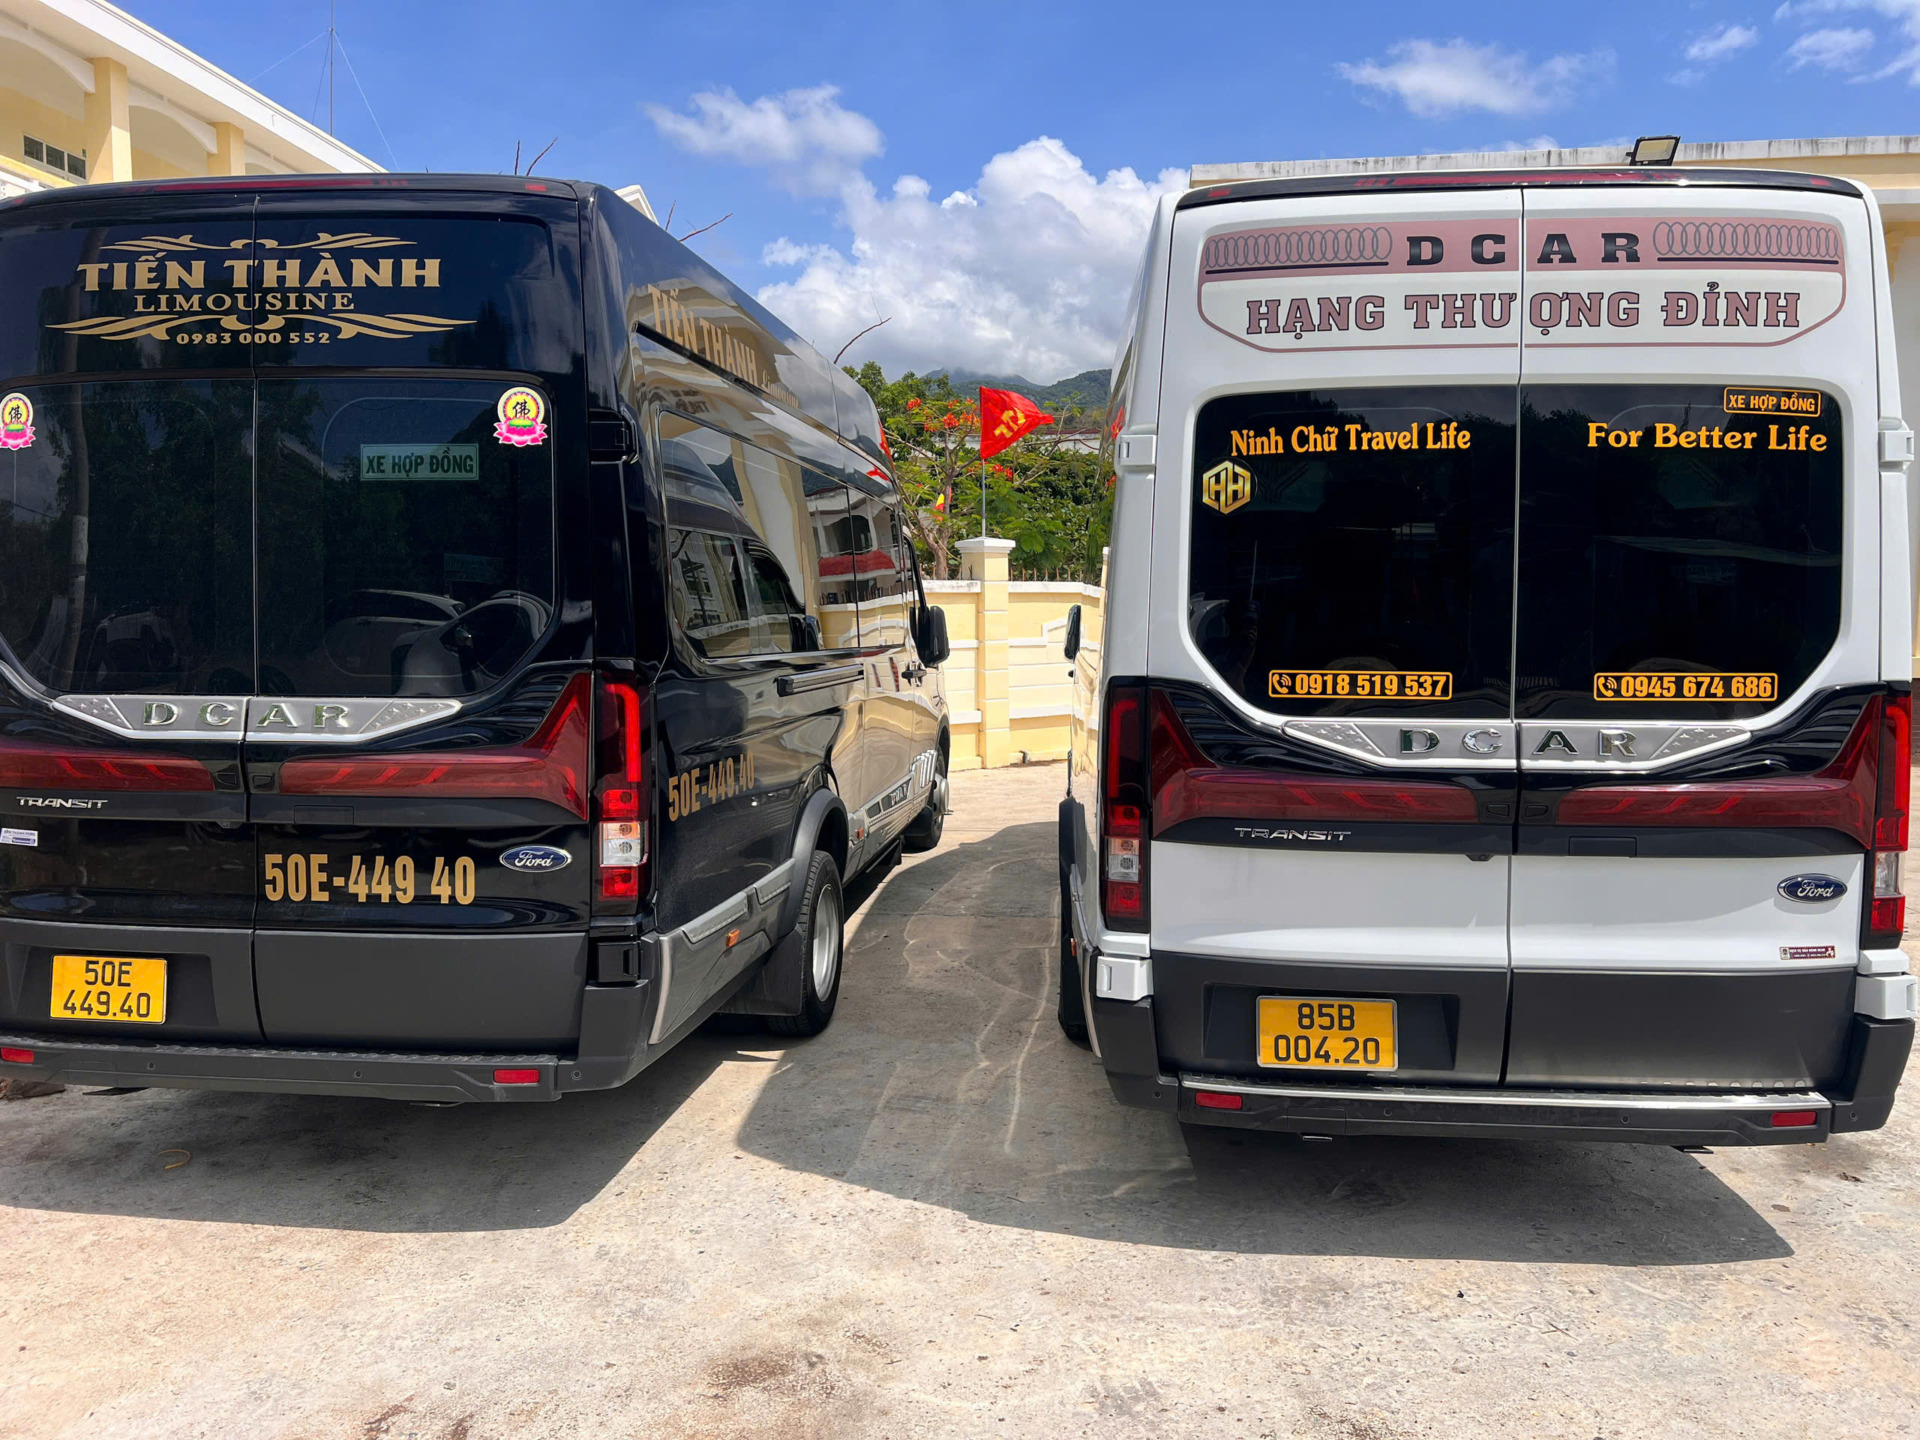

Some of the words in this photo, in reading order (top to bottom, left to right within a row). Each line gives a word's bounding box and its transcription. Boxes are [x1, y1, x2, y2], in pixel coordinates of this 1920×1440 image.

[76, 252, 206, 291] TIẾN
[223, 252, 441, 288] THÀNH
[134, 292, 355, 312] LIMOUSINE
[1246, 294, 1385, 340] HẠNG
[1660, 281, 1800, 328] ĐỈNH
[176, 332, 232, 345] 0983
[239, 332, 282, 344] 000
[289, 332, 331, 344] 552
[648, 283, 698, 354] TIẾN
[699, 317, 759, 388] THÀNH
[1728, 394, 1746, 408] XE
[1750, 393, 1777, 412] HỢP
[1780, 392, 1815, 412] ĐỒNG
[1231, 427, 1284, 456] Ninh
[1291, 425, 1339, 453] Chữ
[1345, 422, 1419, 451] Travel
[1426, 422, 1471, 449] Life
[1587, 422, 1643, 448] For
[1654, 422, 1758, 449] Better
[1768, 424, 1828, 452] Life
[366, 454, 386, 474] XE
[391, 452, 424, 478] HỢP
[429, 447, 474, 474] ĐỒNG
[1295, 674, 1350, 695] 0918
[1357, 674, 1398, 696] 519
[1405, 675, 1447, 696] 537
[1620, 676, 1676, 697] 0945
[1683, 676, 1725, 697] 674
[1731, 676, 1772, 698] 686
[668, 750, 755, 822] 50E-449.40
[16, 796, 108, 808] TRANSIT
[1234, 827, 1351, 841] TRANSIT
[514, 850, 553, 868] Ford
[264, 853, 415, 904] 50E-449
[430, 856, 476, 905] 40
[1797, 880, 1835, 898] Ford
[85, 960, 133, 987] 50E
[63, 989, 151, 1018] 449.40
[1297, 1003, 1355, 1031] 85B
[1274, 1034, 1380, 1065] 004.20
